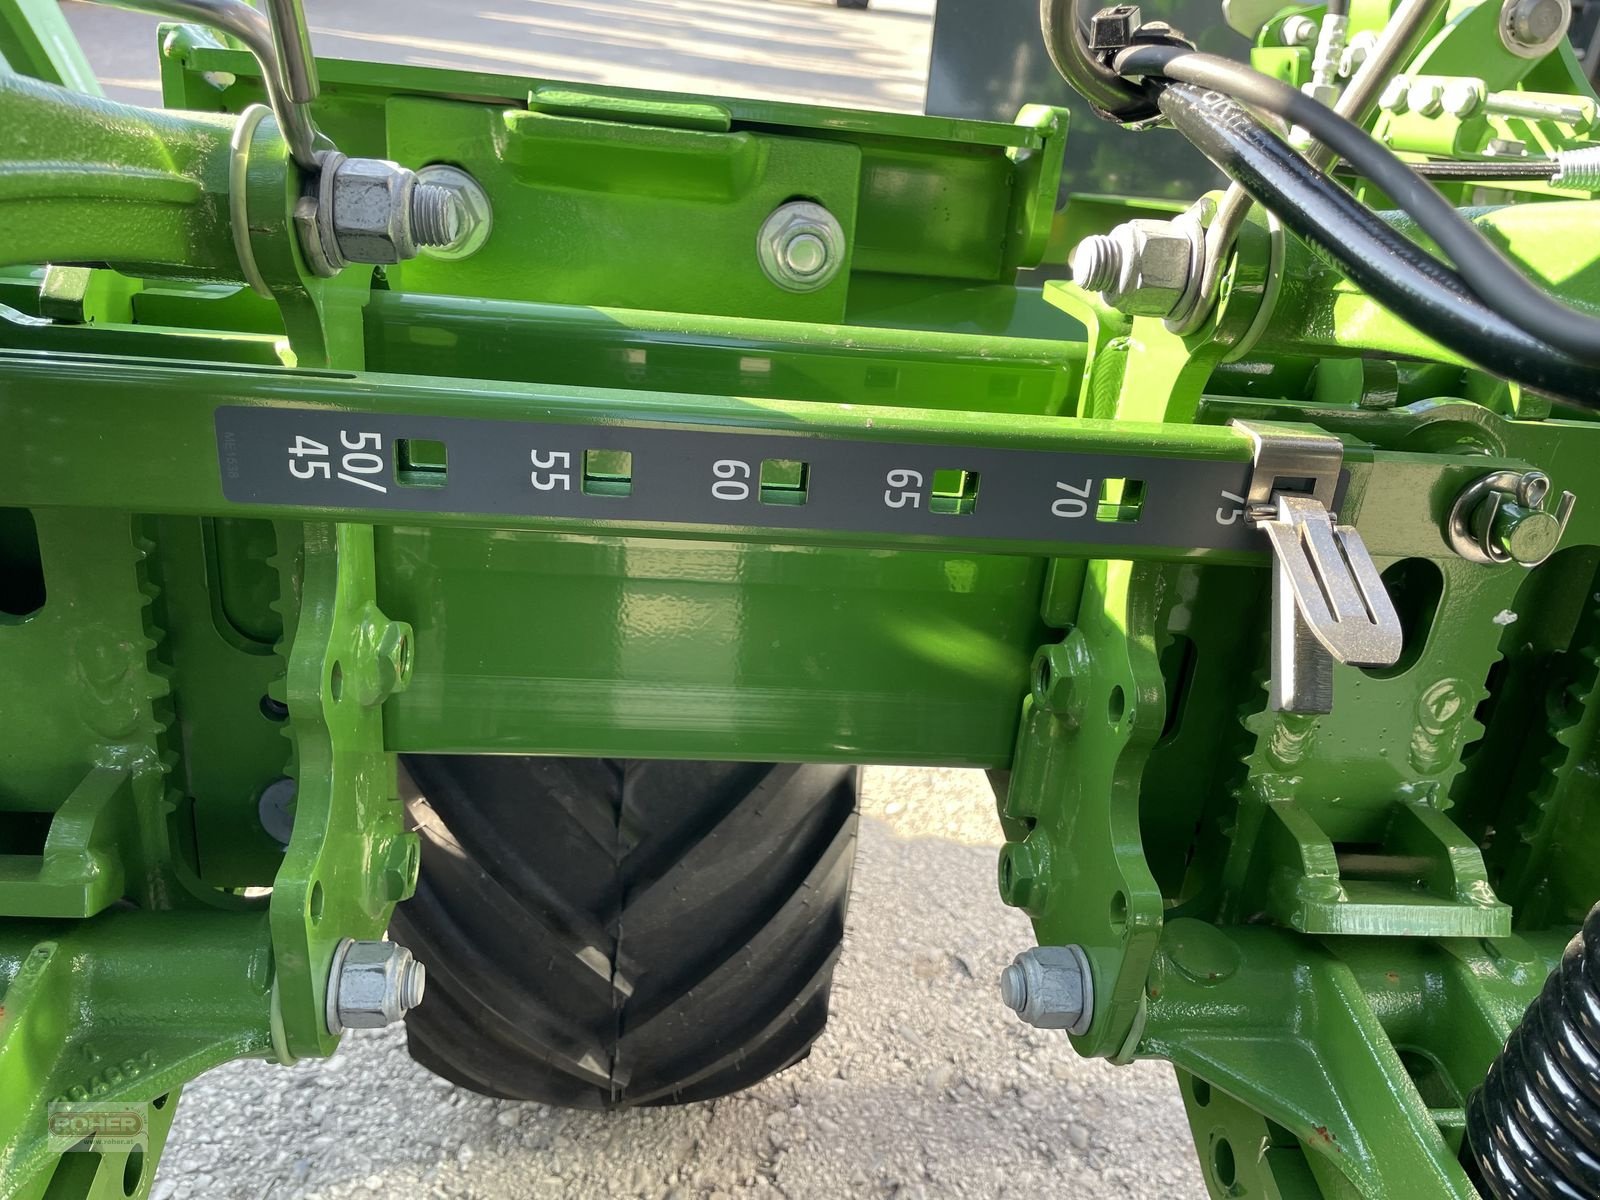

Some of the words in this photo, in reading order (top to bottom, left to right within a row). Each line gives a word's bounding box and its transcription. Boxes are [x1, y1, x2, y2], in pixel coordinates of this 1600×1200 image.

[288, 435, 331, 479] 45
[338, 429, 388, 494] 50/
[530, 448, 571, 491] 55
[711, 459, 751, 501] 60
[885, 469, 923, 509] 65
[1051, 478, 1093, 519] 70
